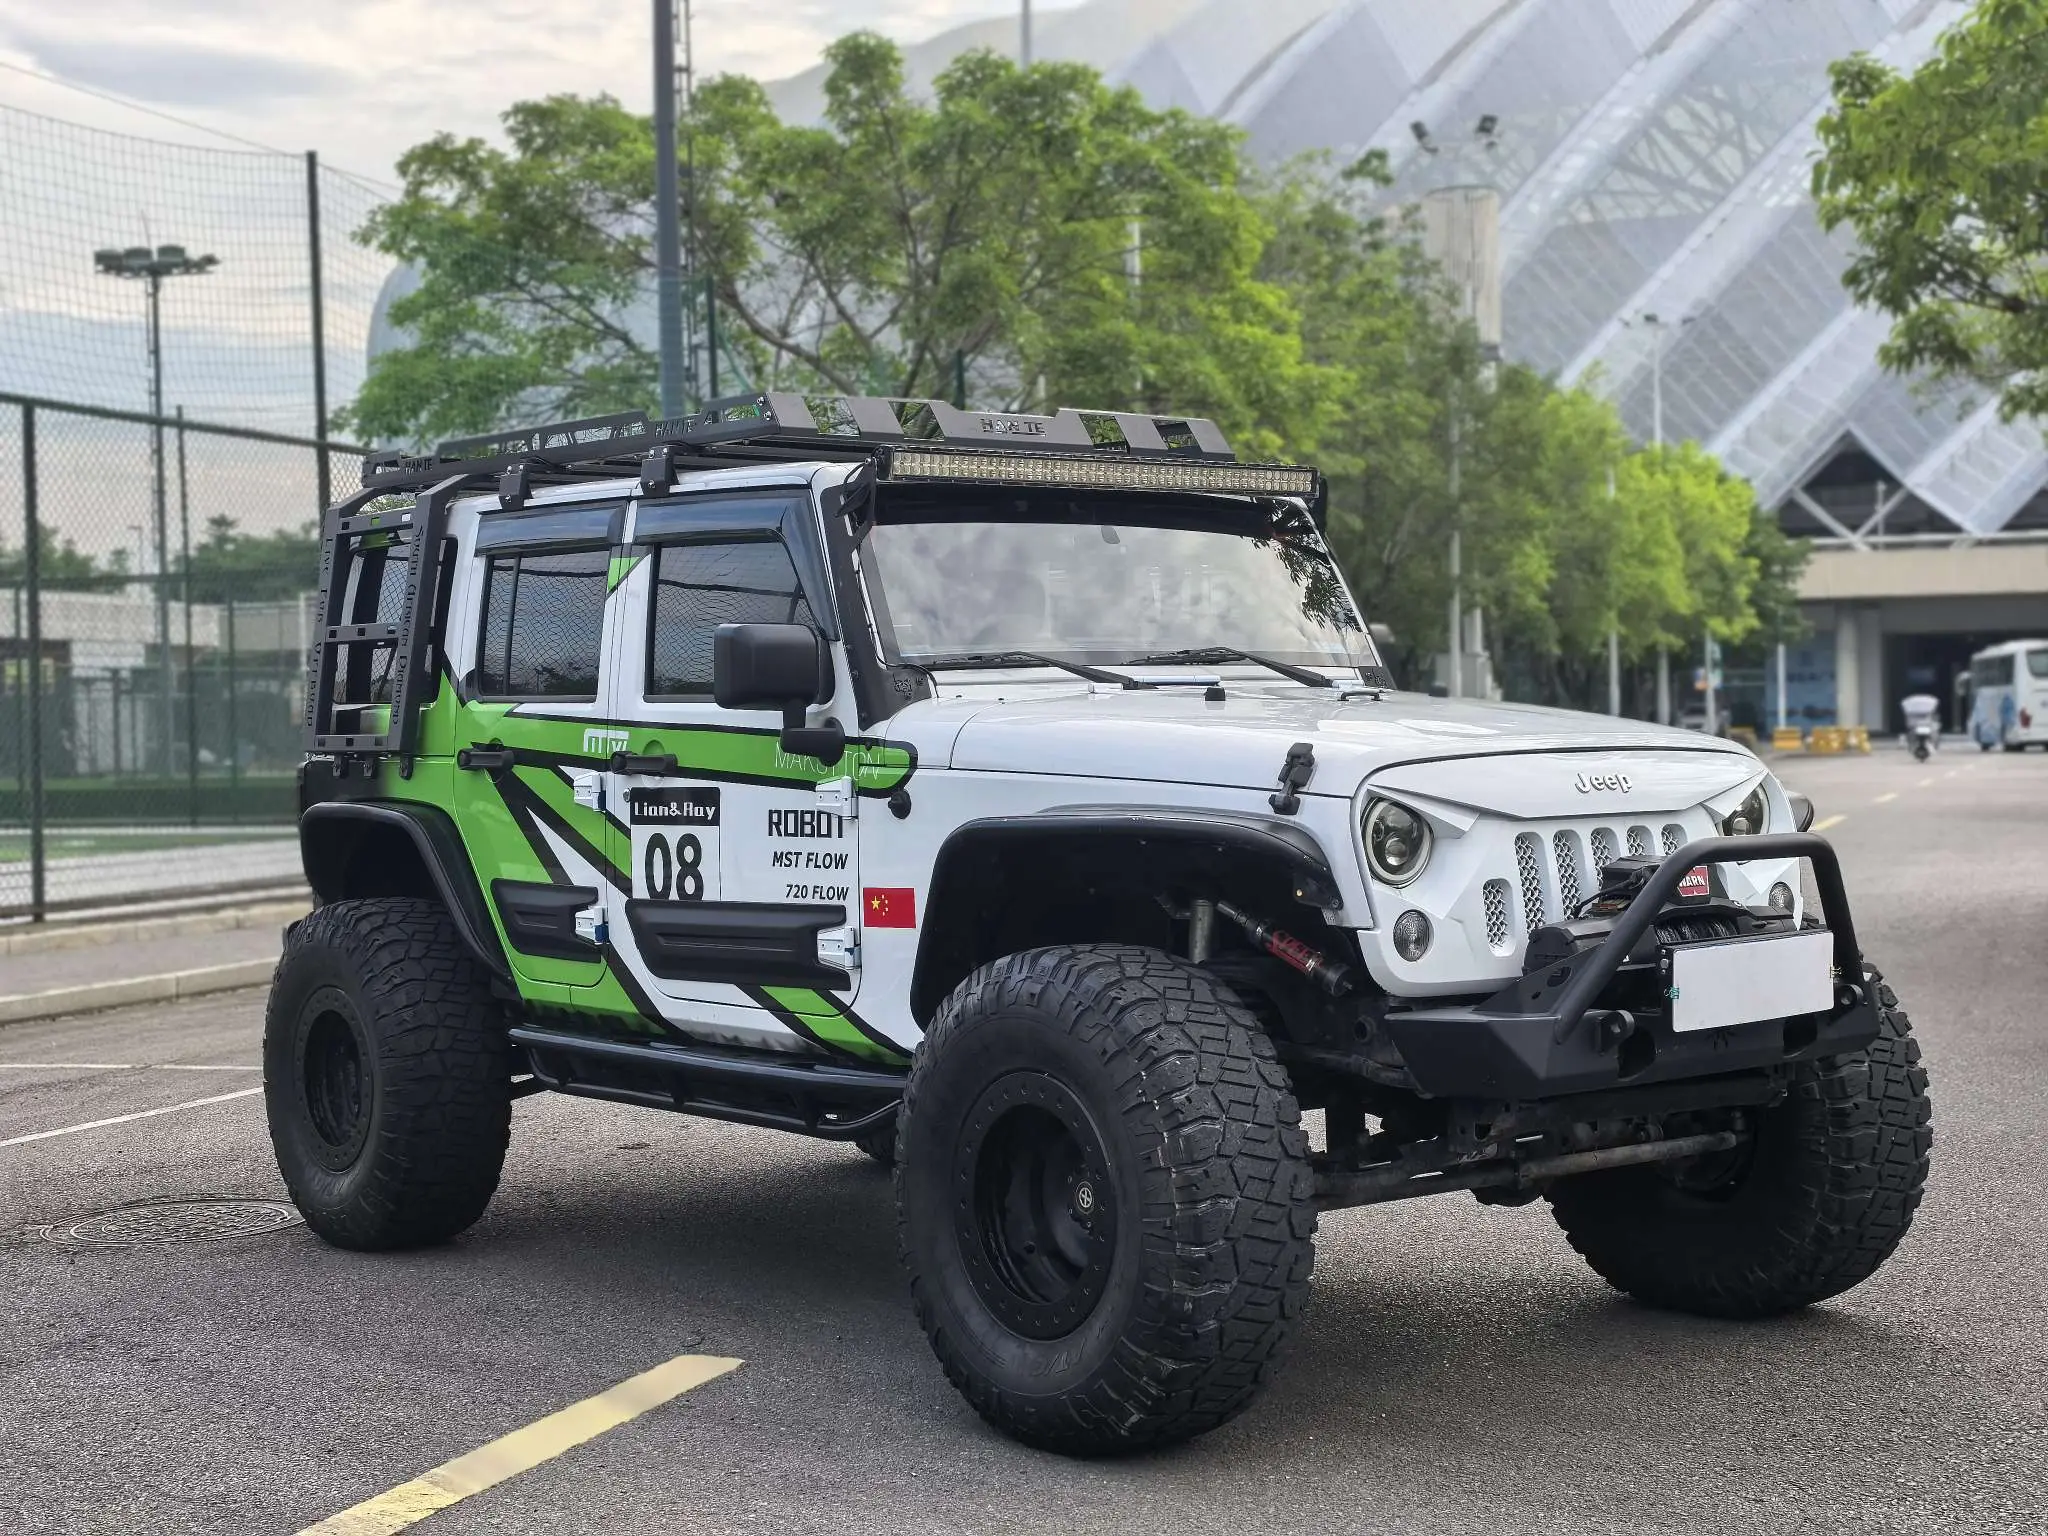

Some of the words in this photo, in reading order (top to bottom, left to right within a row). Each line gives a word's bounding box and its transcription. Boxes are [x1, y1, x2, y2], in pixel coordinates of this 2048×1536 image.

[1575, 772, 1632, 794] Jeep
[645, 833, 704, 900] 08
[772, 851, 802, 868] MST
[805, 852, 848, 870] FLOW
[785, 884, 808, 899] 720
[812, 885, 849, 901] FLOW
